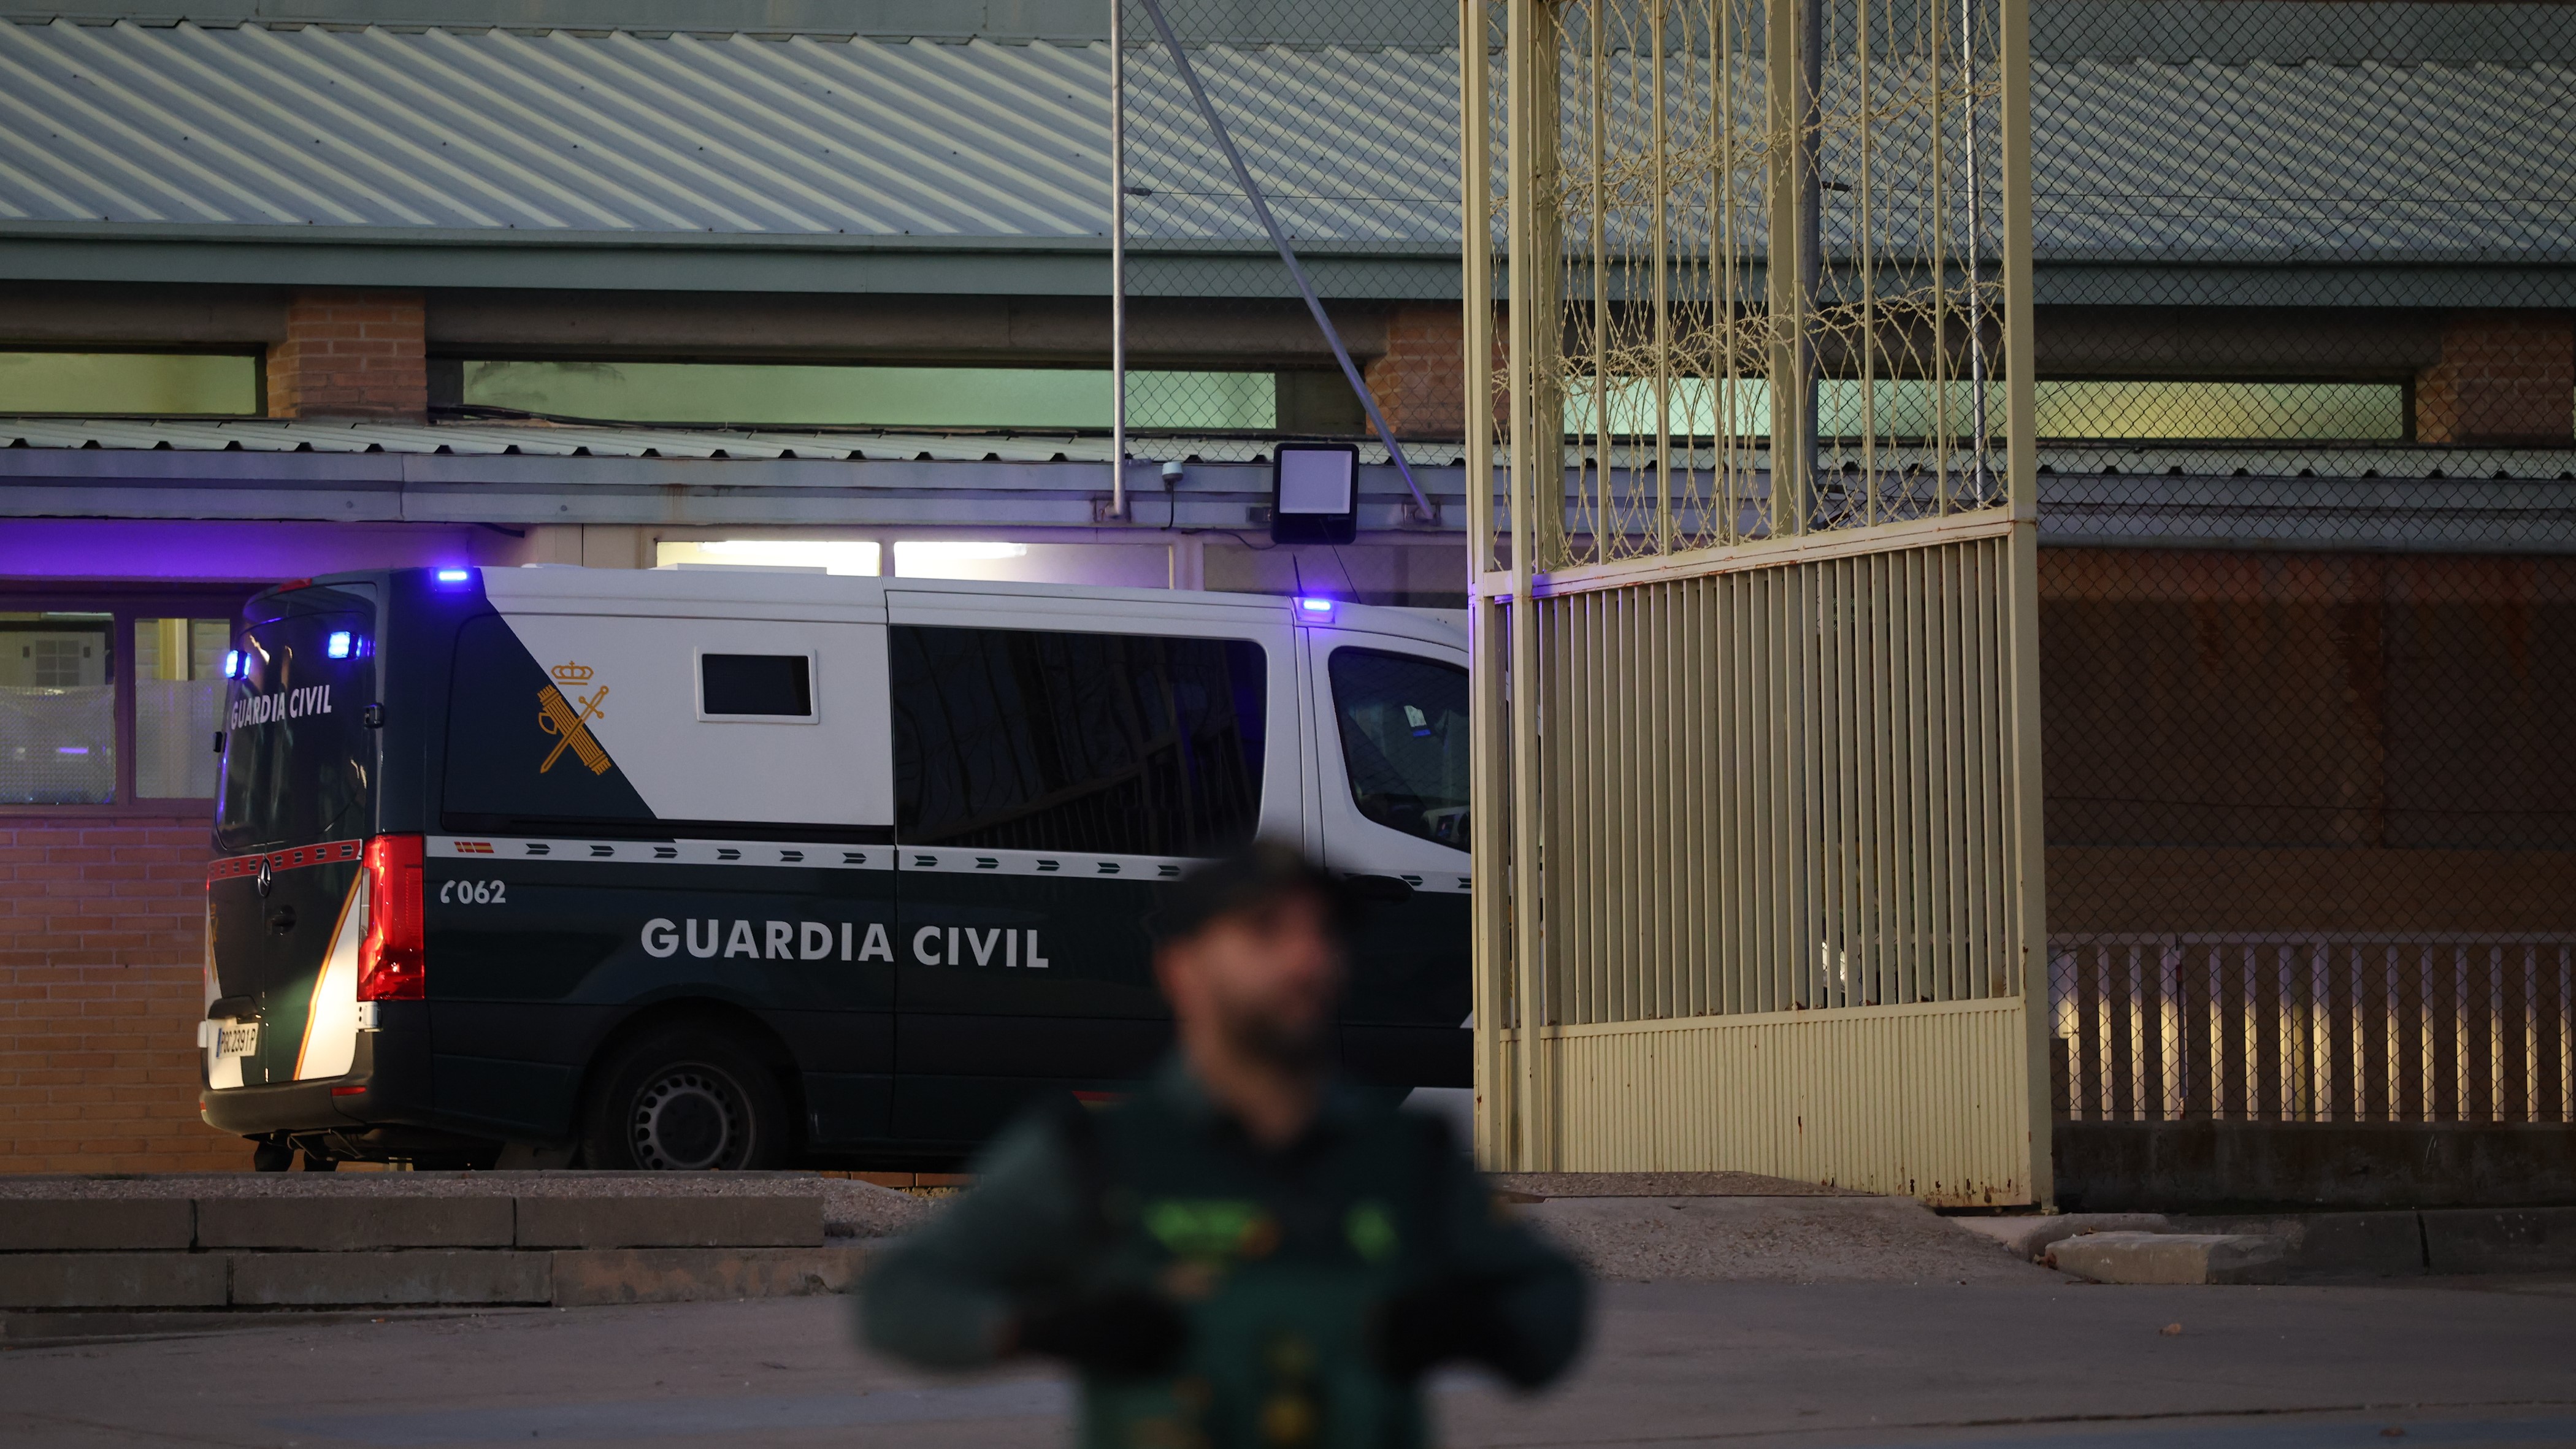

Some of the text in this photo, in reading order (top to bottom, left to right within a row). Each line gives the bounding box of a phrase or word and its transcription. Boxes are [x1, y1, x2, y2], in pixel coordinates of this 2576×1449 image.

[231, 684, 332, 730] GUARDIA CIVIL
[457, 879, 507, 904] 062
[641, 918, 1049, 968] GUARDIA CIVIL
